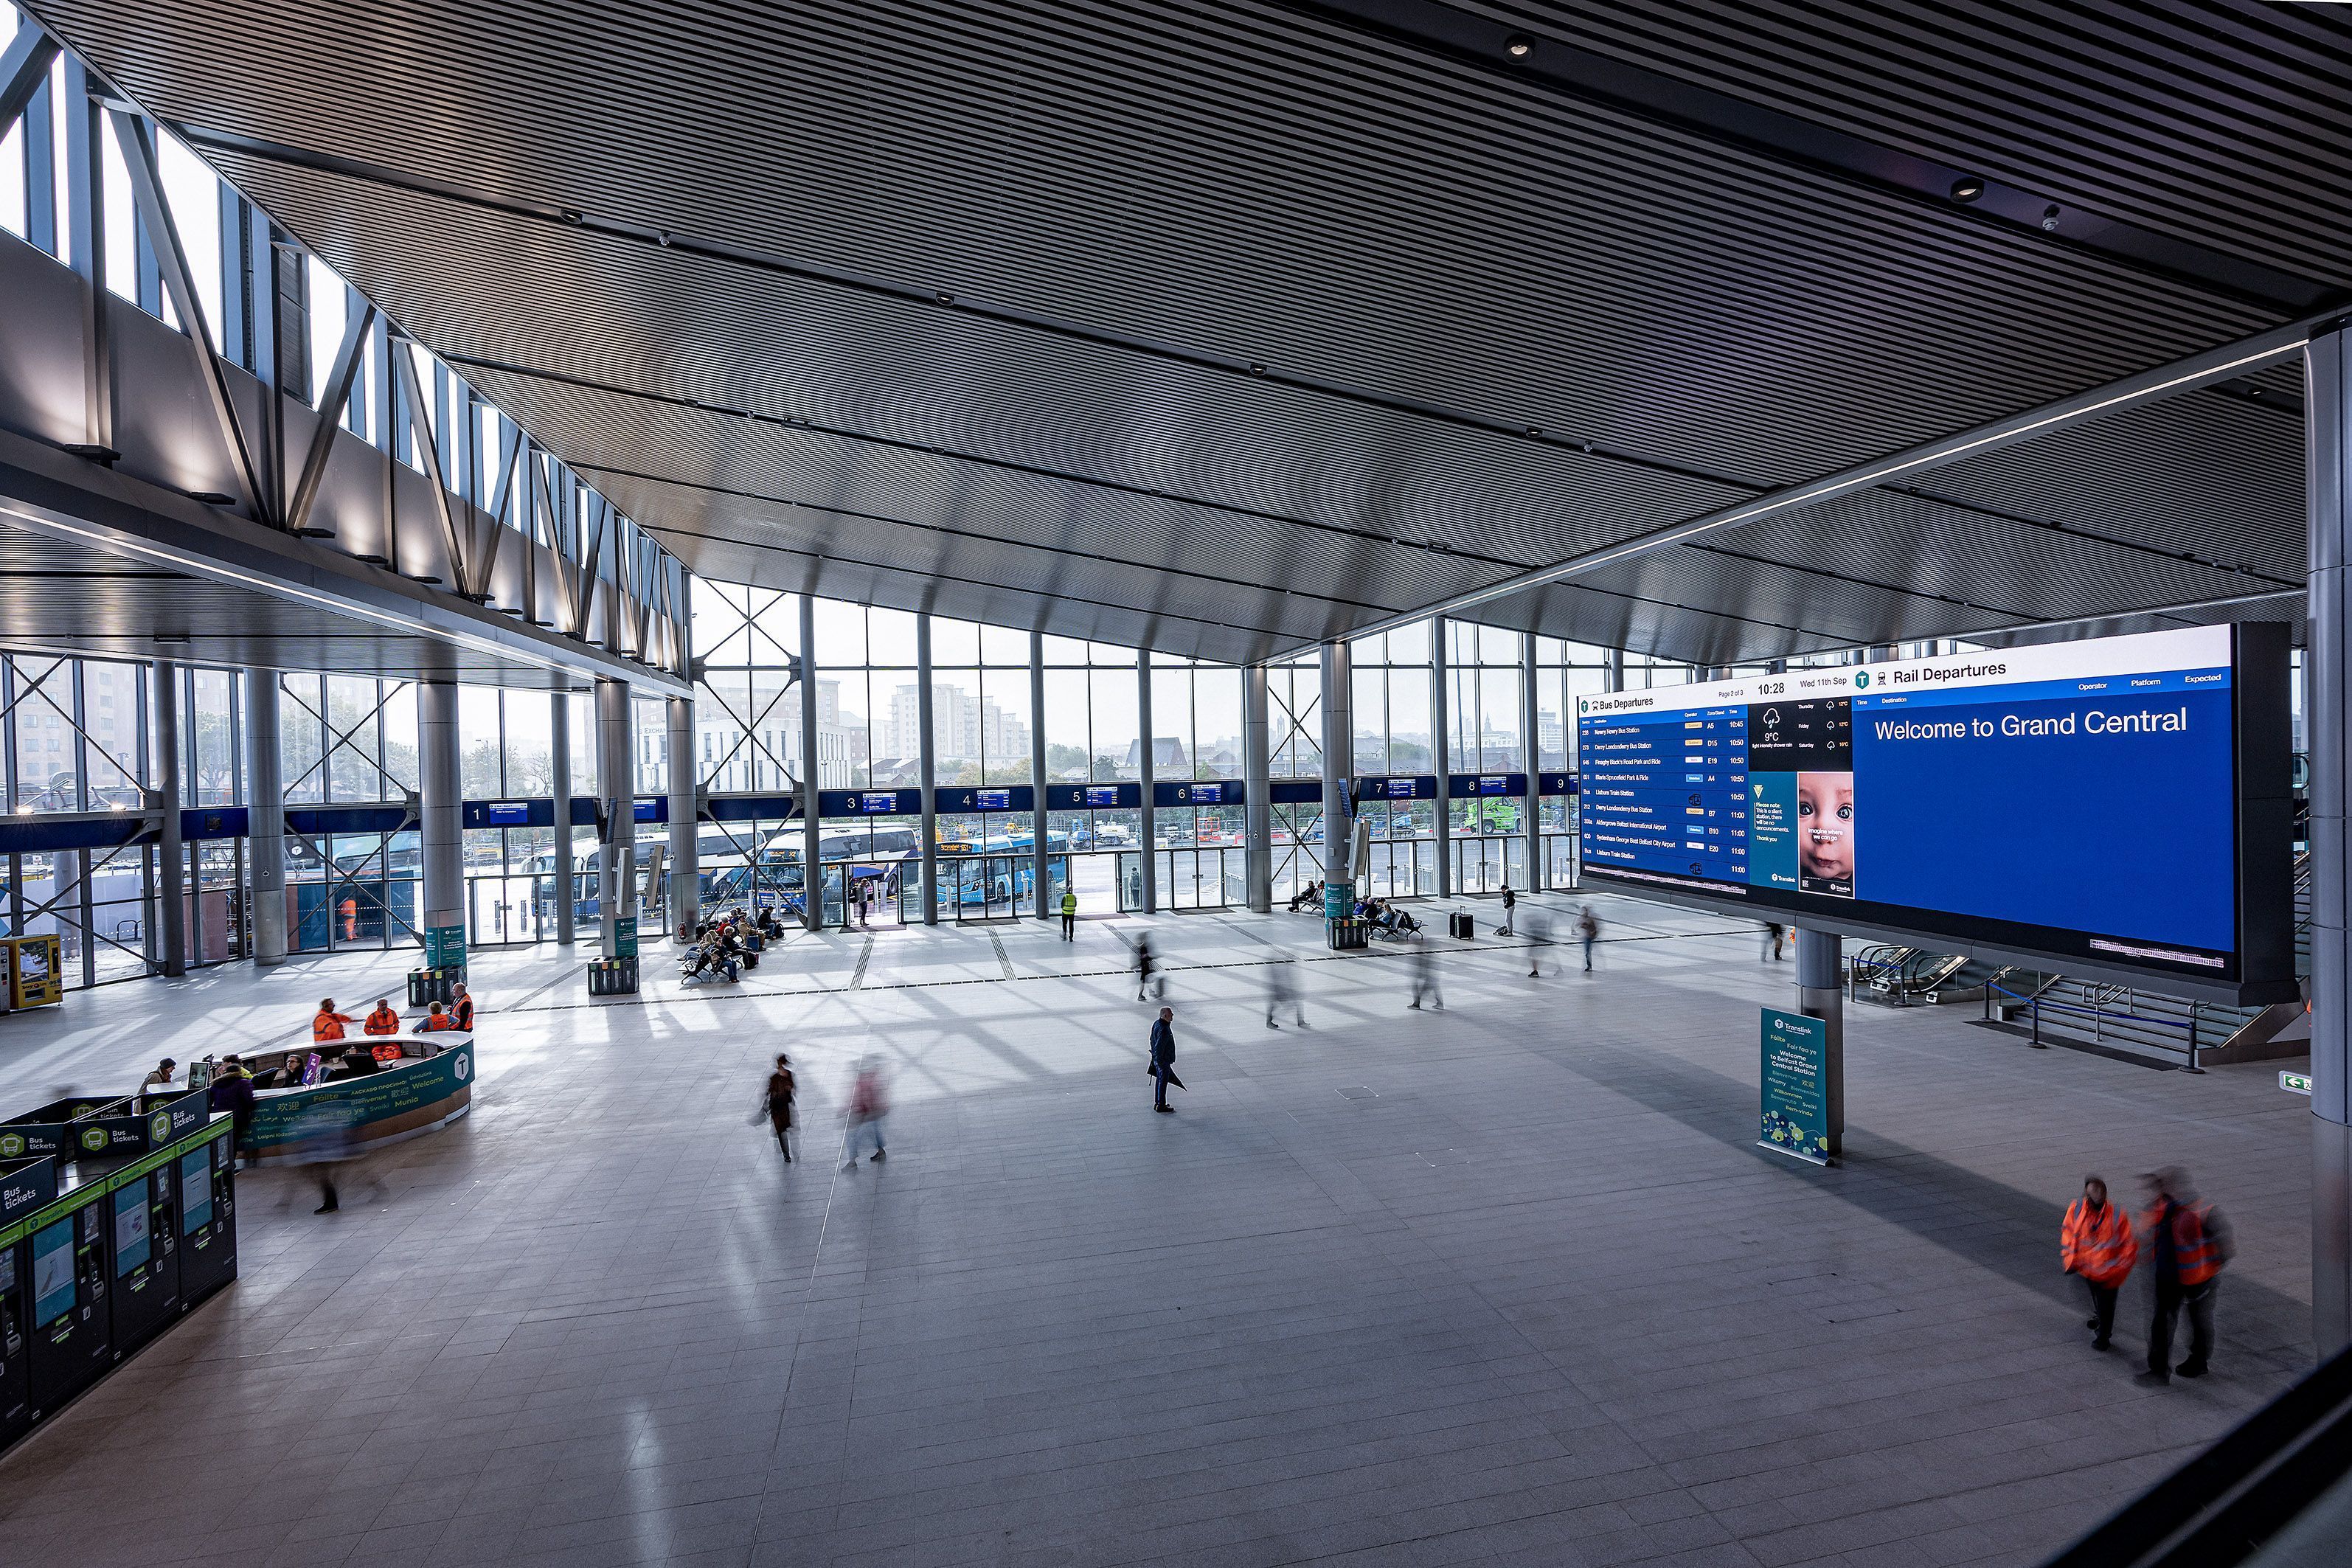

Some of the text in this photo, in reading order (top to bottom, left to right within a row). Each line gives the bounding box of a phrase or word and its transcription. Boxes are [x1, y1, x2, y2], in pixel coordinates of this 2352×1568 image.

[1893, 663, 2006, 684] Rail Departures
[1800, 677, 1847, 687] Wed 11th Sep
[1758, 683, 1784, 695] 10:28
[1882, 696, 1907, 704] Destination
[2078, 682, 2107, 691] Operator
[2131, 679, 2161, 687] Platform
[2185, 674, 2221, 684] Expected
[1600, 697, 1653, 710] Bus Departures
[1875, 707, 2187, 740] Welcome to Grand Central
[1376, 784, 1382, 793] 7
[1469, 781, 1475, 791] 8
[1558, 779, 1564, 788] 9
[1073, 791, 1080, 802] 5
[1179, 789, 1185, 798] 6
[847, 798, 855, 808] 3
[963, 795, 971, 805] 4
[473, 809, 479, 819] 1
[1785, 1023, 1811, 1035] Translink
[1799, 1045, 1808, 1053] faa
[1780, 1050, 1806, 1061] Welcome
[1777, 1055, 1797, 1066] Belfast
[1799, 1061, 1817, 1070] Grand
[1772, 1061, 1815, 1077] Central Station
[1772, 1070, 1797, 1080] Bienvenue
[412, 1076, 443, 1089] Welcome
[1768, 1077, 1786, 1086] Witamy
[1774, 1088, 1802, 1100] Willkommen
[1791, 1086, 1819, 1097] Bienvenidos
[313, 1093, 339, 1102] Fáilte
[351, 1095, 386, 1106] Bienvenue
[395, 1097, 418, 1107] Munia
[1771, 1094, 1797, 1105] Benvenuto
[277, 1101, 299, 1111] 欢迎
[370, 1103, 389, 1112] Sveiki
[1786, 1106, 1813, 1117] Bem-vindo
[1803, 1102, 1817, 1110] Sveiki
[173, 1109, 185, 1120] Bus
[354, 1108, 364, 1116] ye
[174, 1113, 195, 1128] tickets
[113, 1134, 139, 1142] tickets
[4, 1186, 20, 1201] Bus
[4, 1189, 36, 1210] tickets
[41, 1207, 64, 1223] Translink
